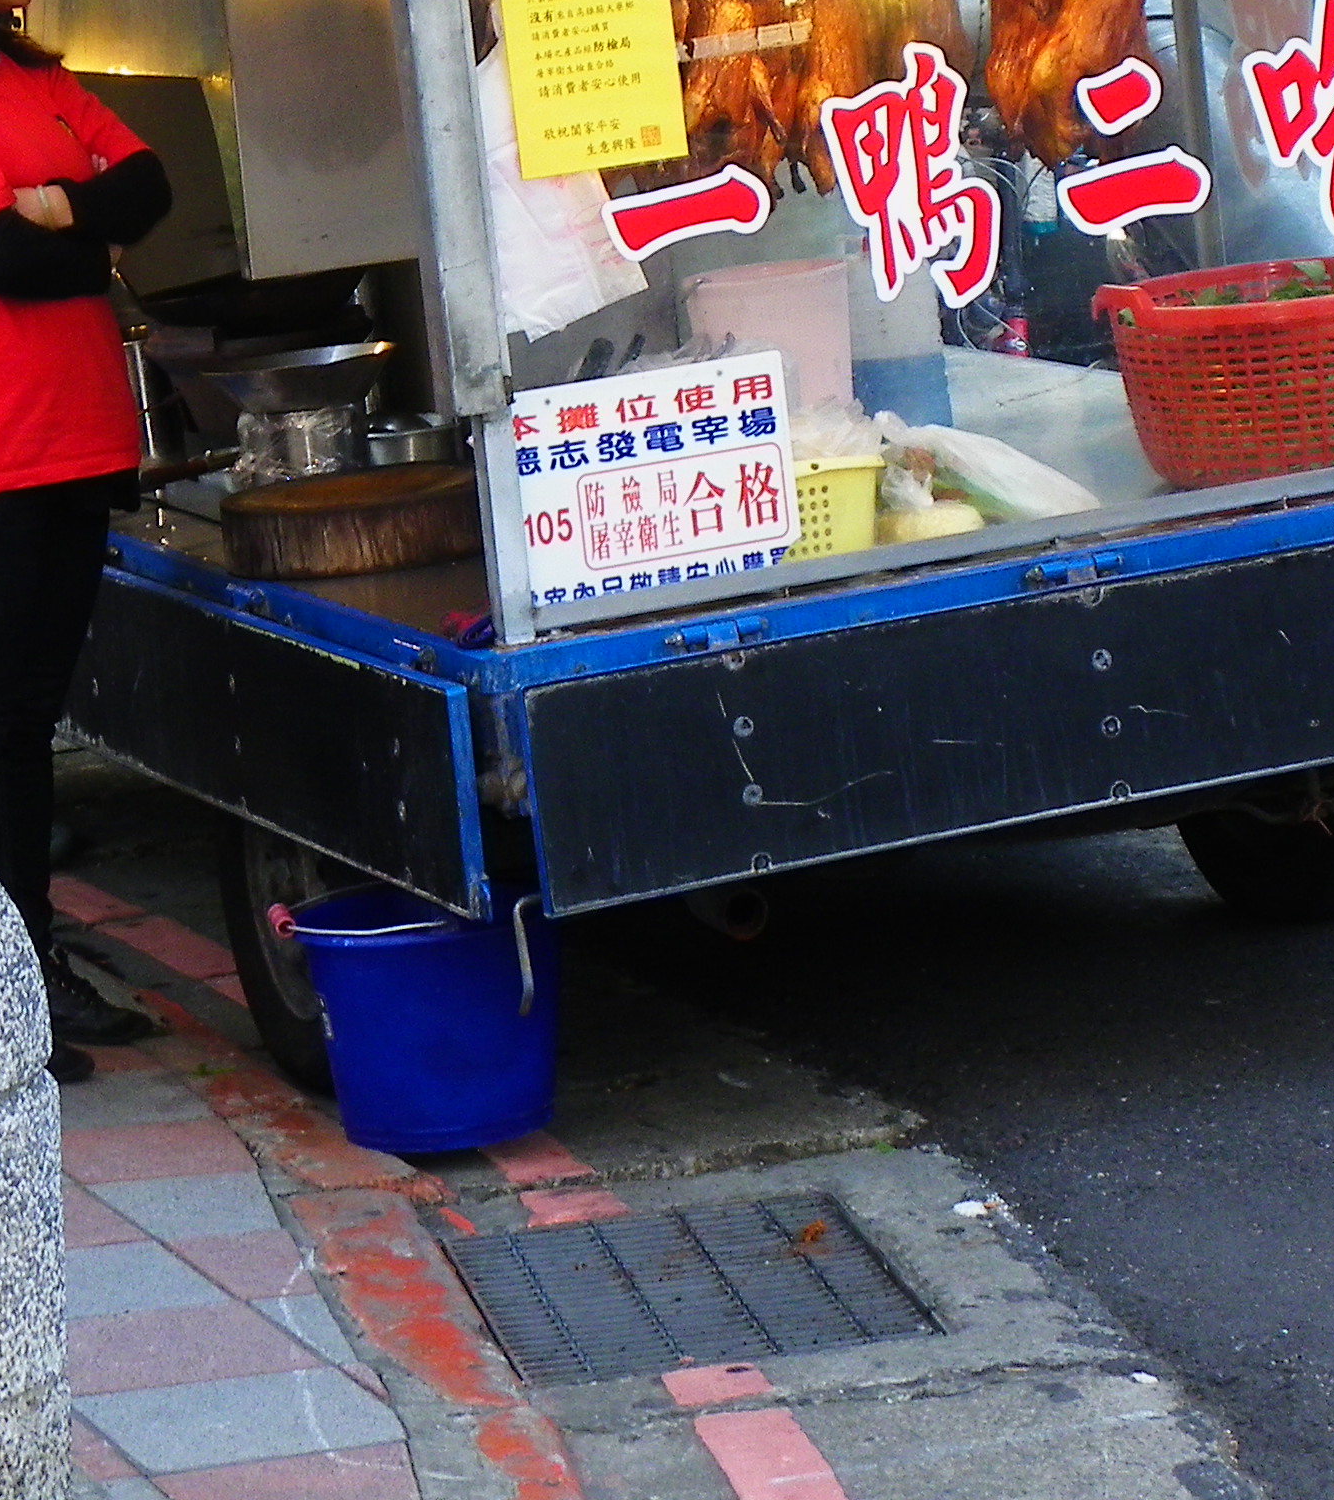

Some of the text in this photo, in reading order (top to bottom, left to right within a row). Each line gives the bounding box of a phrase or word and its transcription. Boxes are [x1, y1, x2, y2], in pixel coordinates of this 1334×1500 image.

[513, 373, 773, 441] 本攤位使用
[584, 469, 678, 521] 防檢局
[683, 461, 780, 538] 合格
[524, 508, 574, 548] 105
[589, 510, 684, 562] 屠宰衛生
